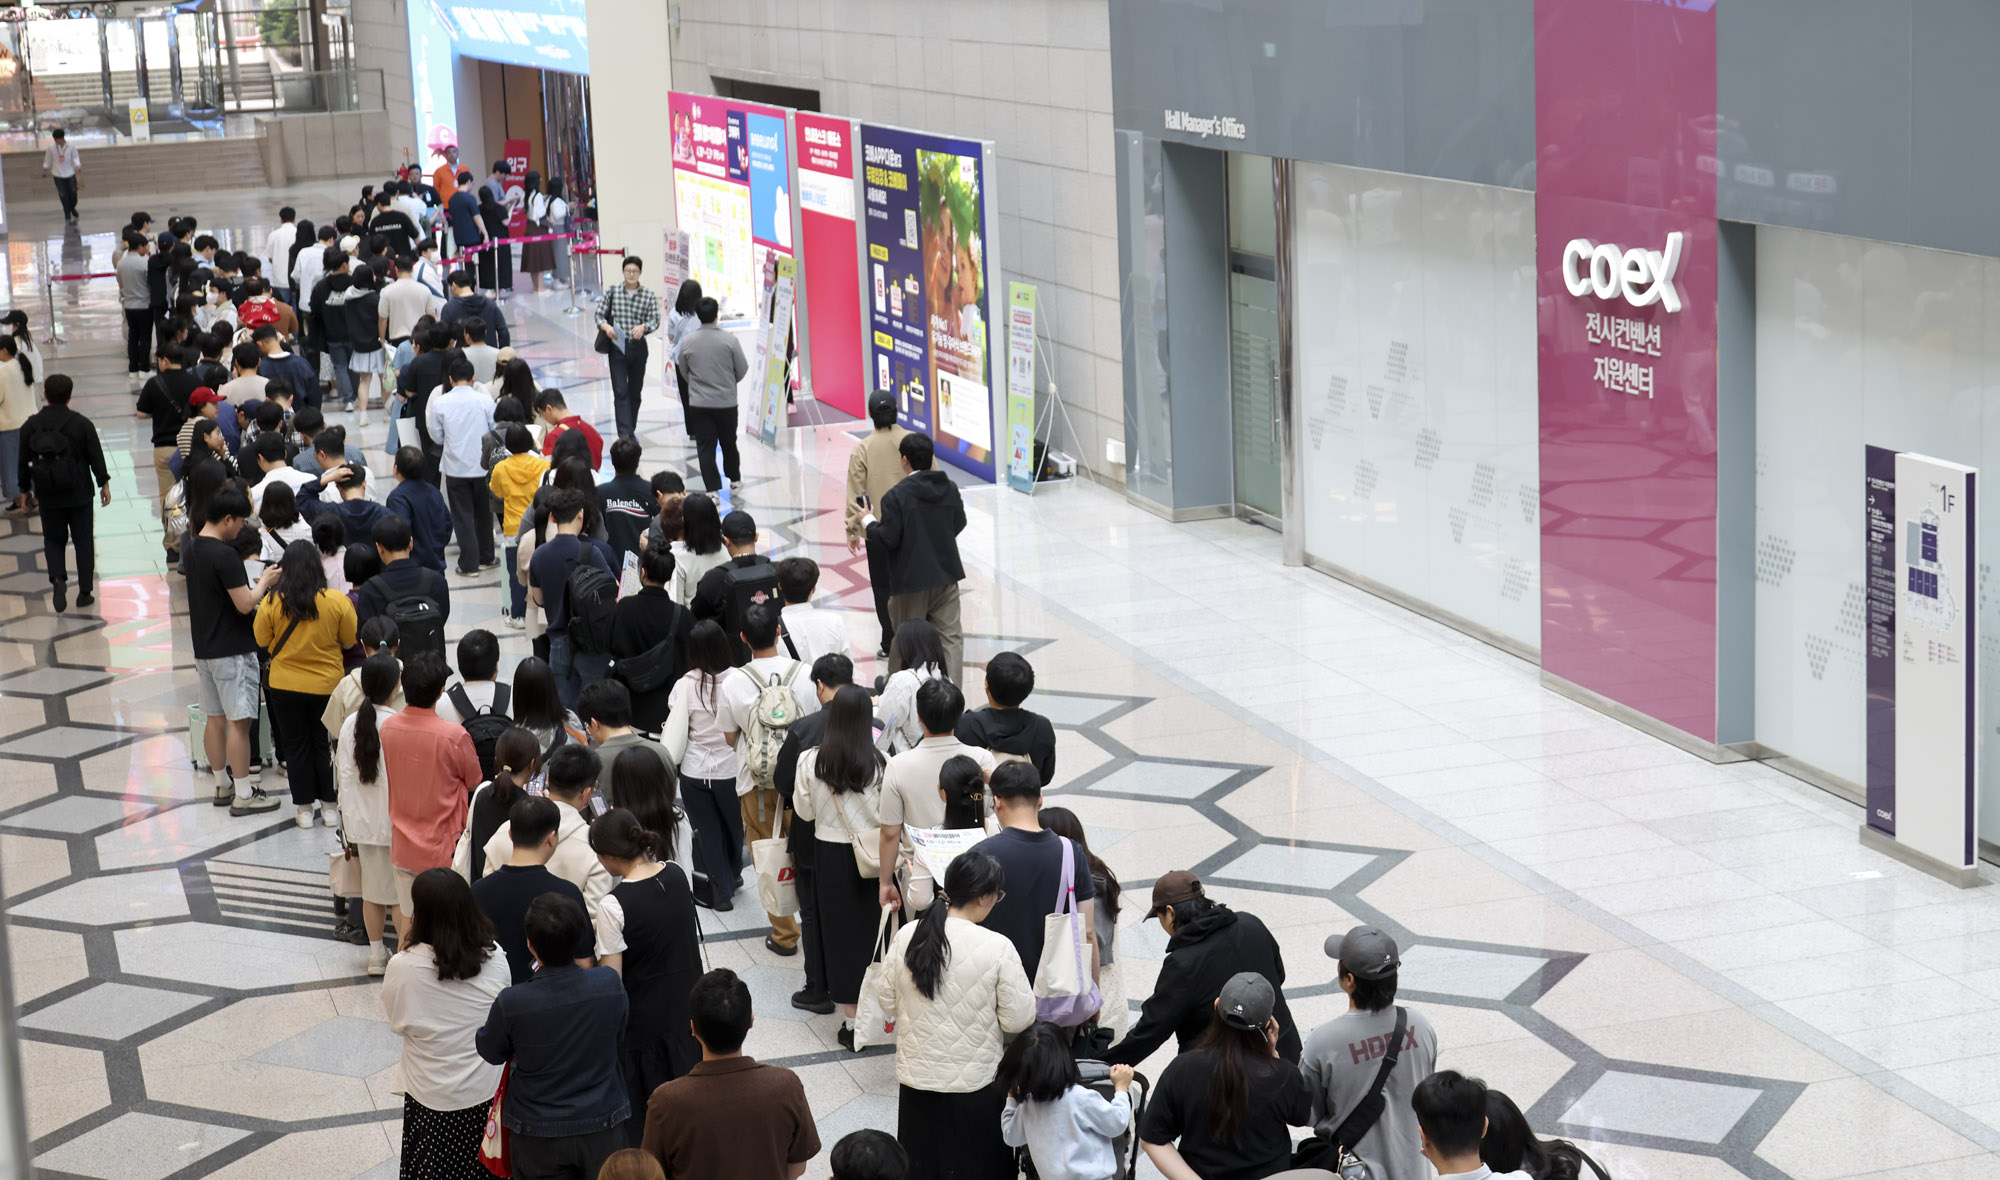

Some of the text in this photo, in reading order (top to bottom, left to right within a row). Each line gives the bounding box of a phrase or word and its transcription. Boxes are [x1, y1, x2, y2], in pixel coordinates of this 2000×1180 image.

[1165, 109, 1246, 139] Hall Manager's Office
[506, 157, 528, 173] 입구
[1562, 231, 1684, 313] coex
[1585, 312, 1661, 357] 전시컨벤션
[1593, 356, 1654, 399] 지원센터
[1940, 484, 1955, 513] 1F
